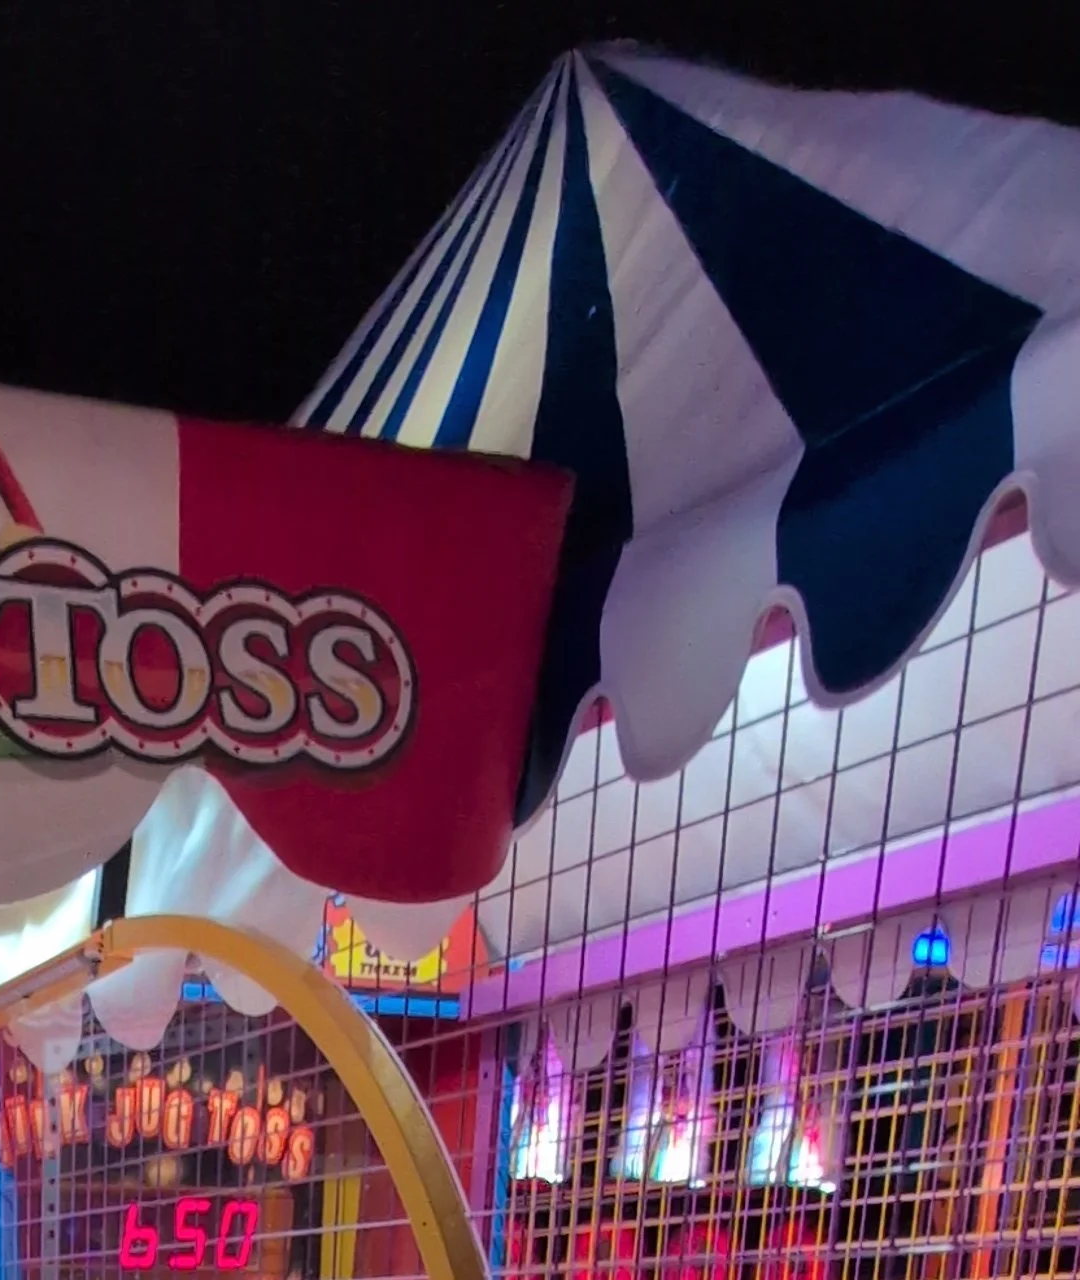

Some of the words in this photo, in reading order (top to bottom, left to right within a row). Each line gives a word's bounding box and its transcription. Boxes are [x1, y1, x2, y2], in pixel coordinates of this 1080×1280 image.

[107, 1077, 194, 1149] JUG
[208, 1088, 315, 1181] TOSS
[120, 1196, 261, 1270] 650
